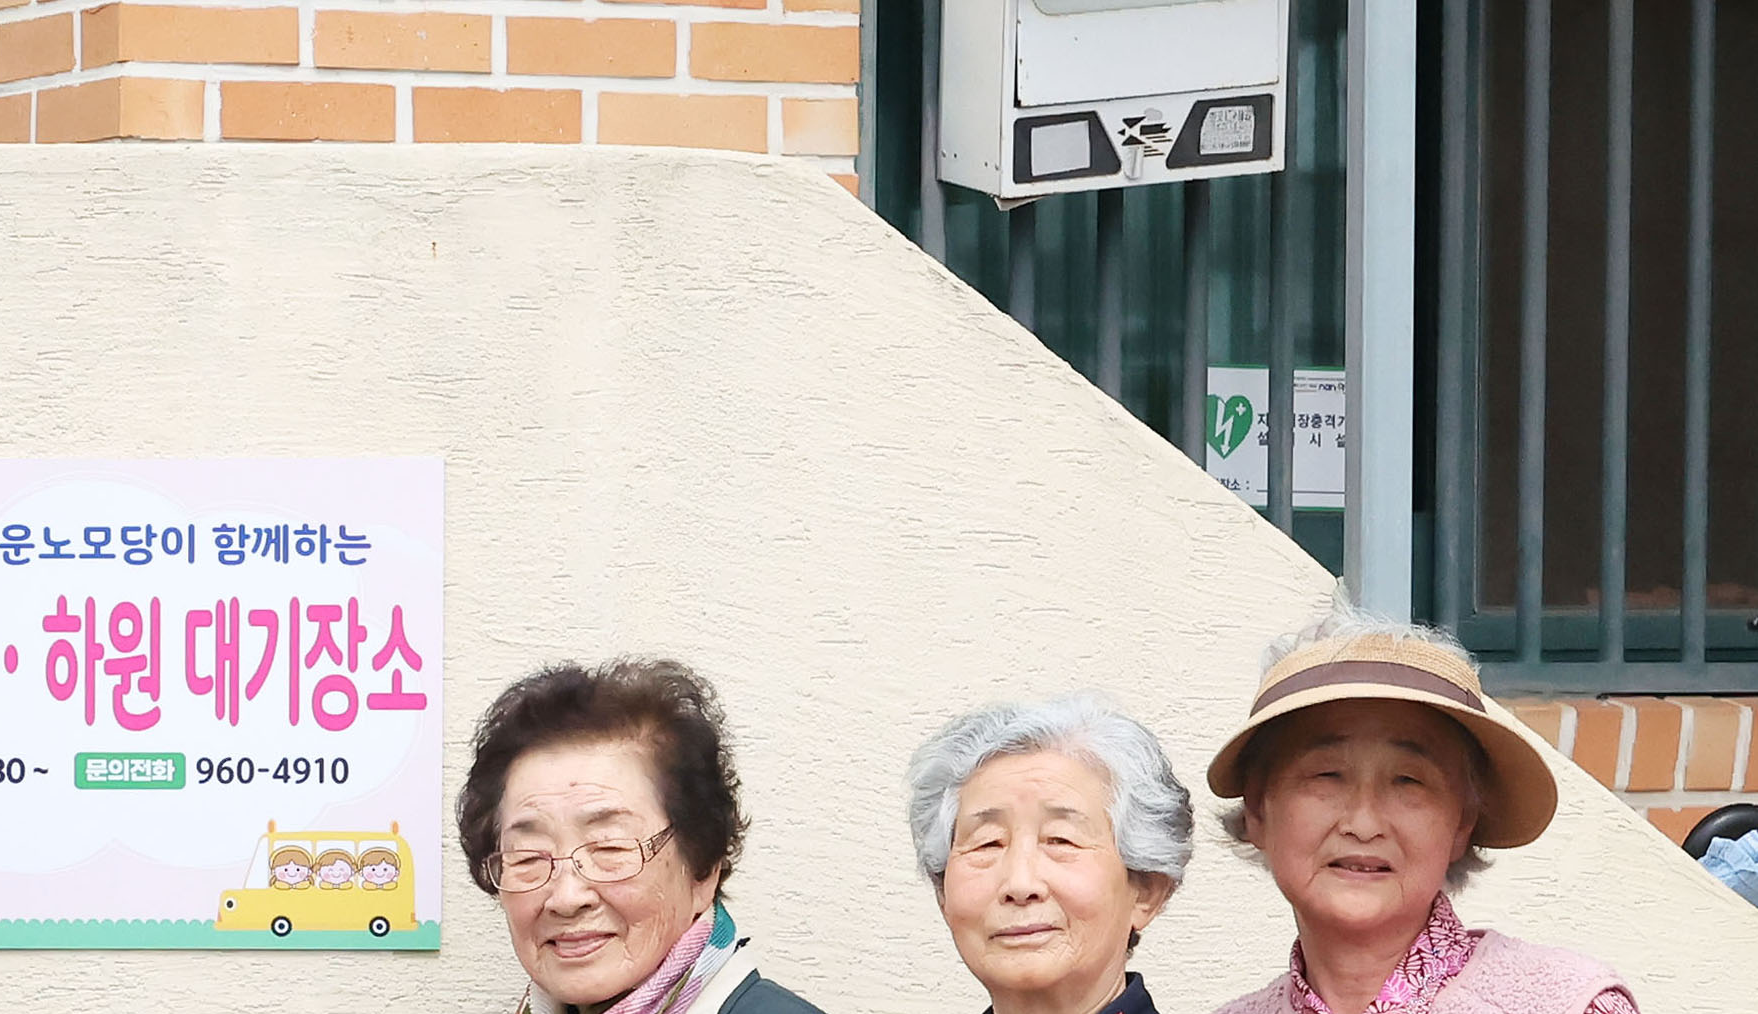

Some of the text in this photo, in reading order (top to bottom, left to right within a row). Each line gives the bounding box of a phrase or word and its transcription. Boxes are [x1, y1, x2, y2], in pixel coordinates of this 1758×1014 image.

[212, 522, 373, 567] 함께하는
[185, 595, 429, 732] 대기장소
[84, 757, 177, 783] 문의전화
[195, 756, 350, 786] 960-4910
